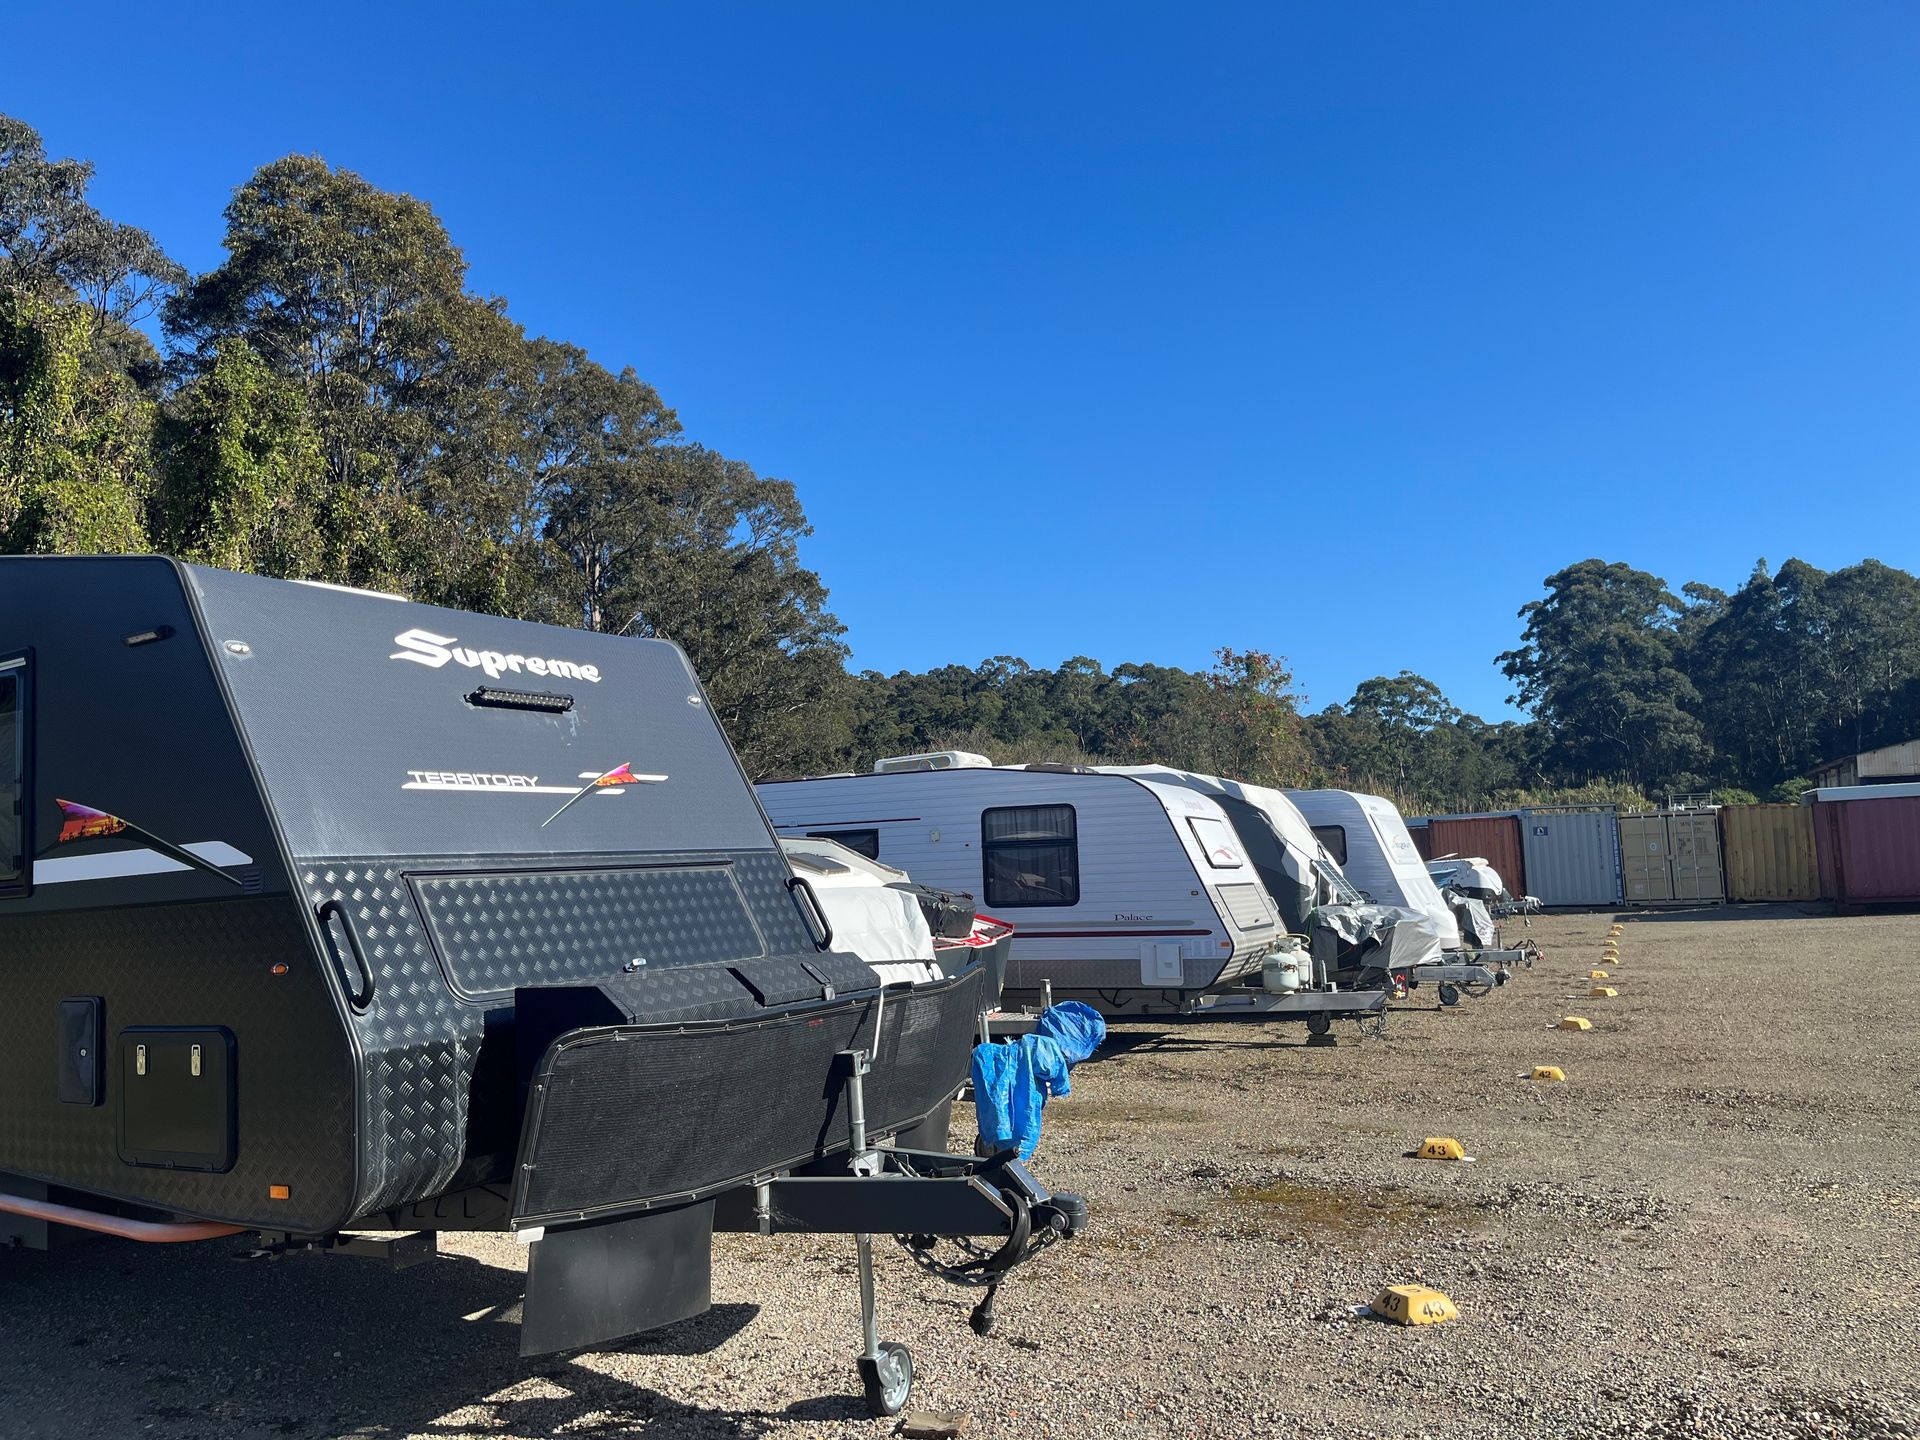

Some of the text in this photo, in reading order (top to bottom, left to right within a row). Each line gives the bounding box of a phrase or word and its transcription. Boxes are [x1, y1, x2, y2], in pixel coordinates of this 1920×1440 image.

[389, 628, 602, 683] Supreme
[407, 771, 539, 787] TERRITORY
[1538, 1071, 1552, 1079] 42
[1427, 1145, 1446, 1156] 43
[1381, 1294, 1400, 1312] 43
[1422, 1301, 1446, 1319] 43
